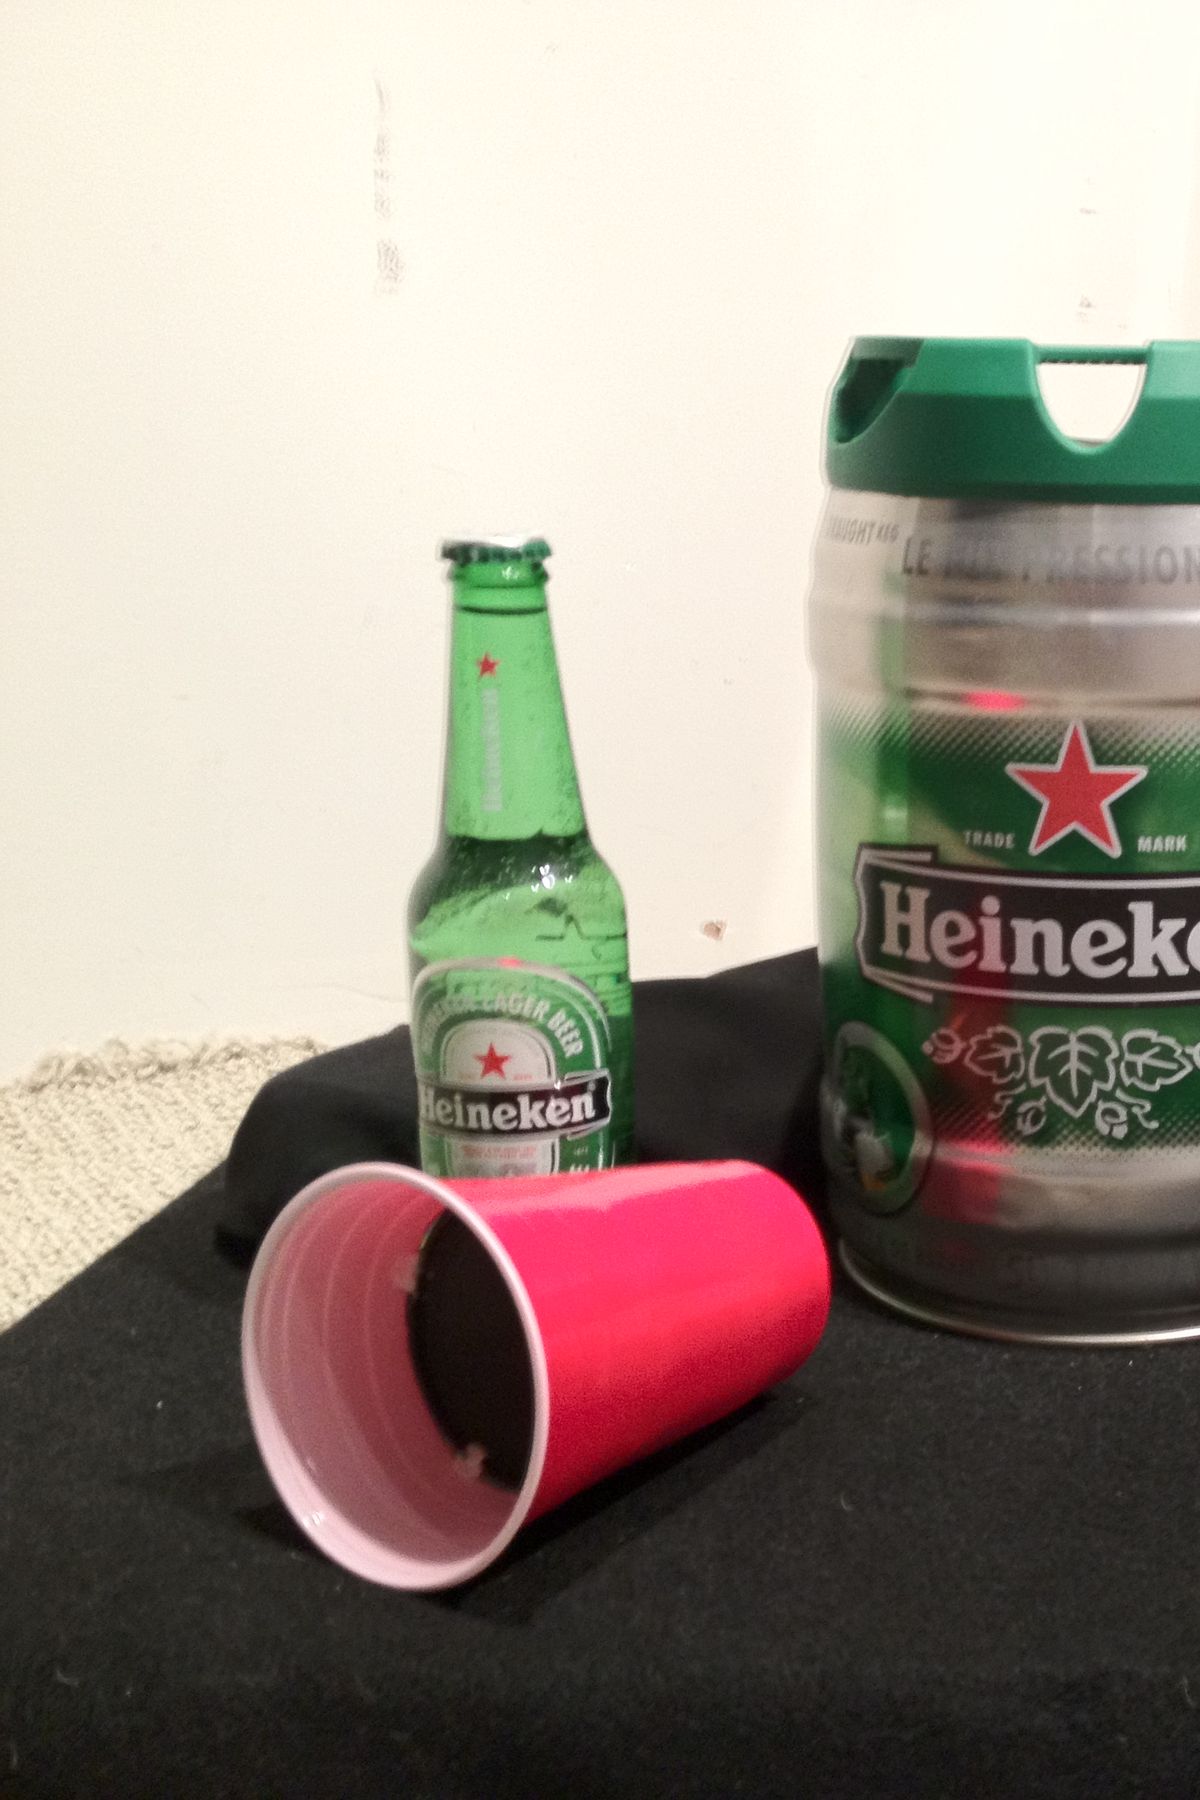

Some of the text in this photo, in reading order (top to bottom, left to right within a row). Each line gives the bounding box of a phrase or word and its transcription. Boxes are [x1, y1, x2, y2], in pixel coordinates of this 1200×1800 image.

[902, 536, 932, 576] LE
[964, 830, 1188, 853] TRADE MARK
[547, 1008, 584, 1059] BEER
